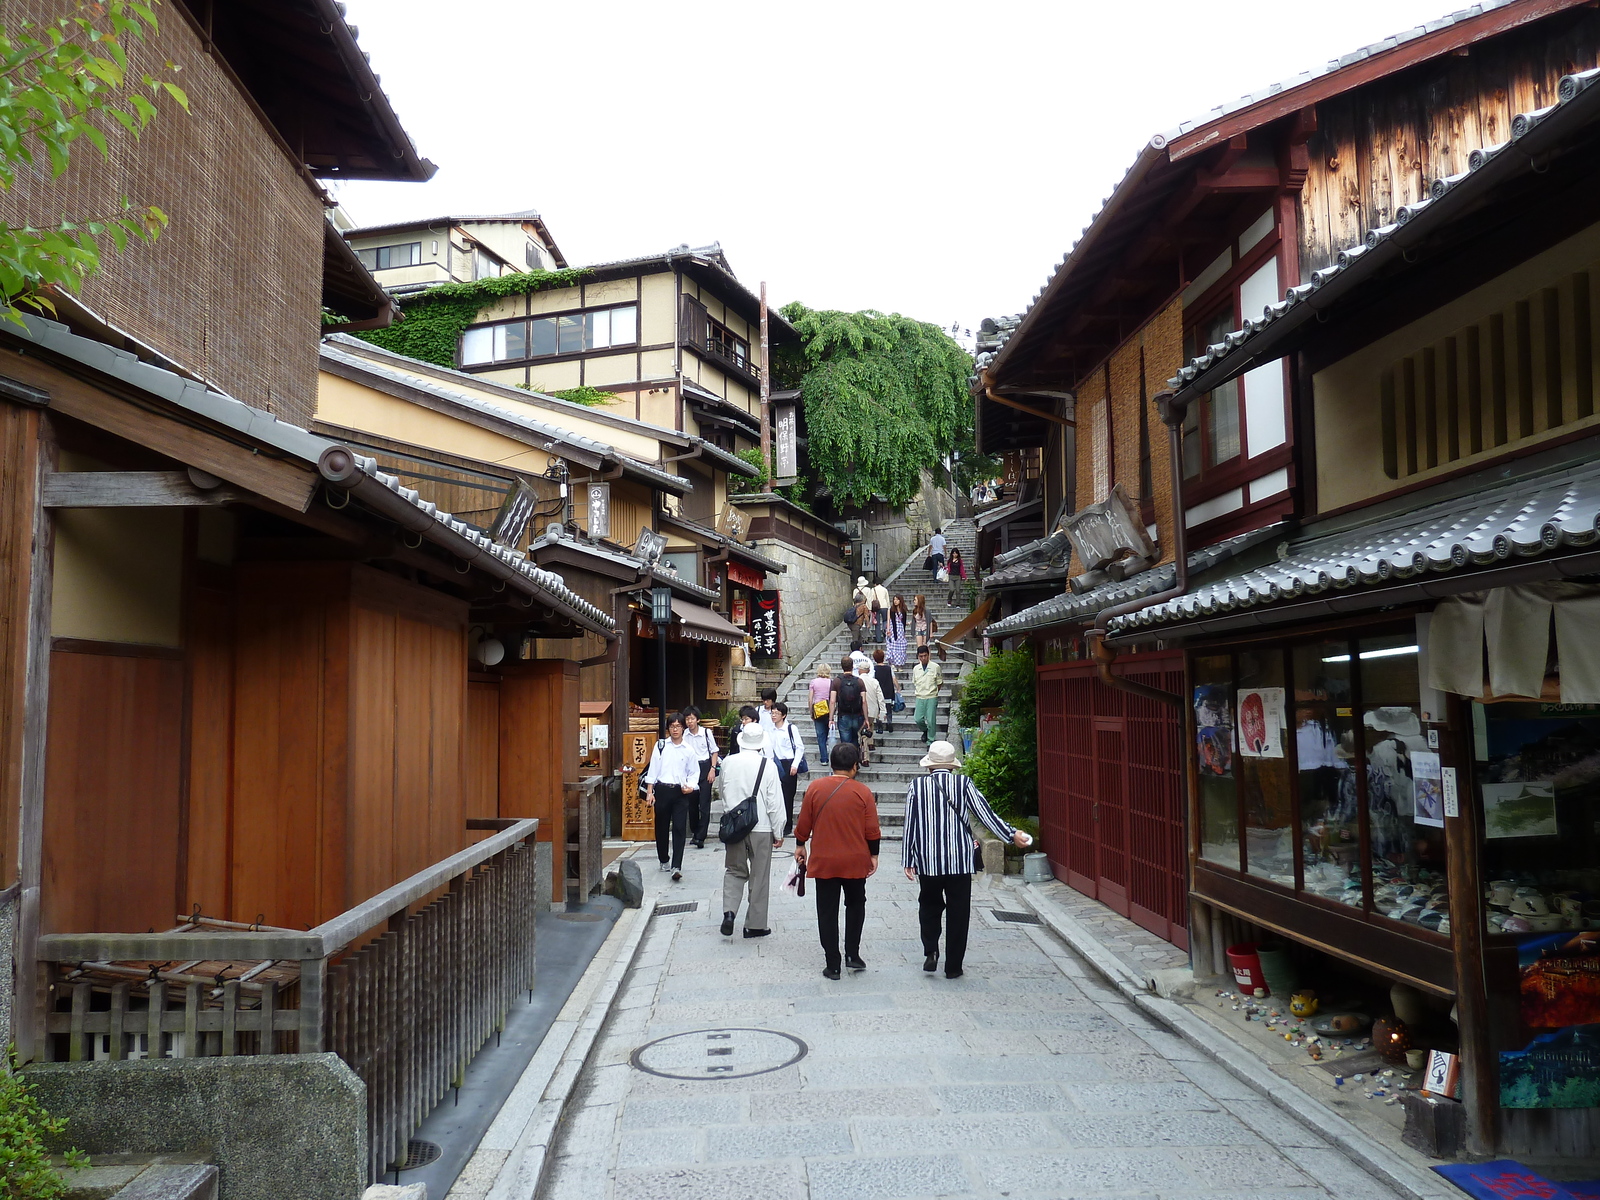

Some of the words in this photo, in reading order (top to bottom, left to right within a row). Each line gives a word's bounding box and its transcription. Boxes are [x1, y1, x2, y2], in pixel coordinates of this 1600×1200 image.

[763, 609, 777, 655] 世界一辛い
[635, 738, 645, 762] エンドウ
